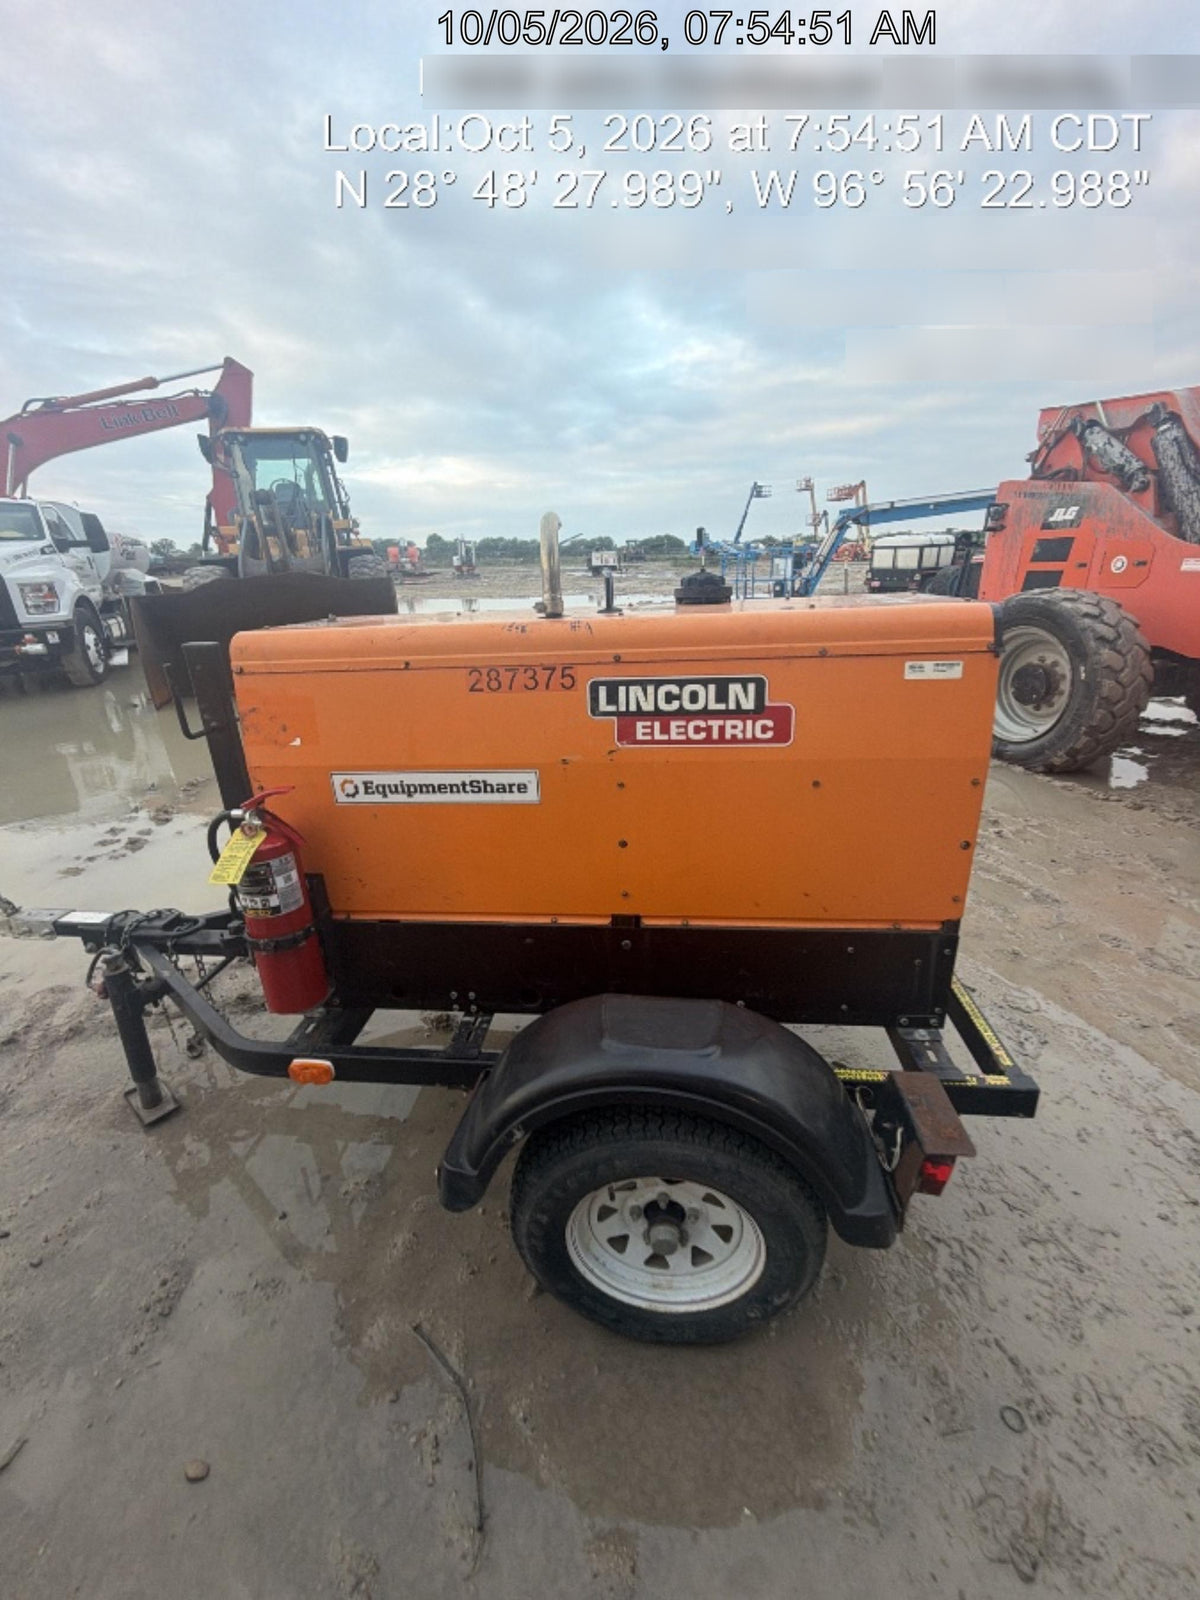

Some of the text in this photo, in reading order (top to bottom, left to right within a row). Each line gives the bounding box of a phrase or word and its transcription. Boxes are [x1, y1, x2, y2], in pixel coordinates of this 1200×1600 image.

[1048, 506, 1080, 521] JLG
[468, 666, 576, 692] 287375
[598, 682, 756, 712] LINCOLN
[636, 719, 774, 741] ELECTRIC
[362, 780, 528, 798] EquipmentShare
